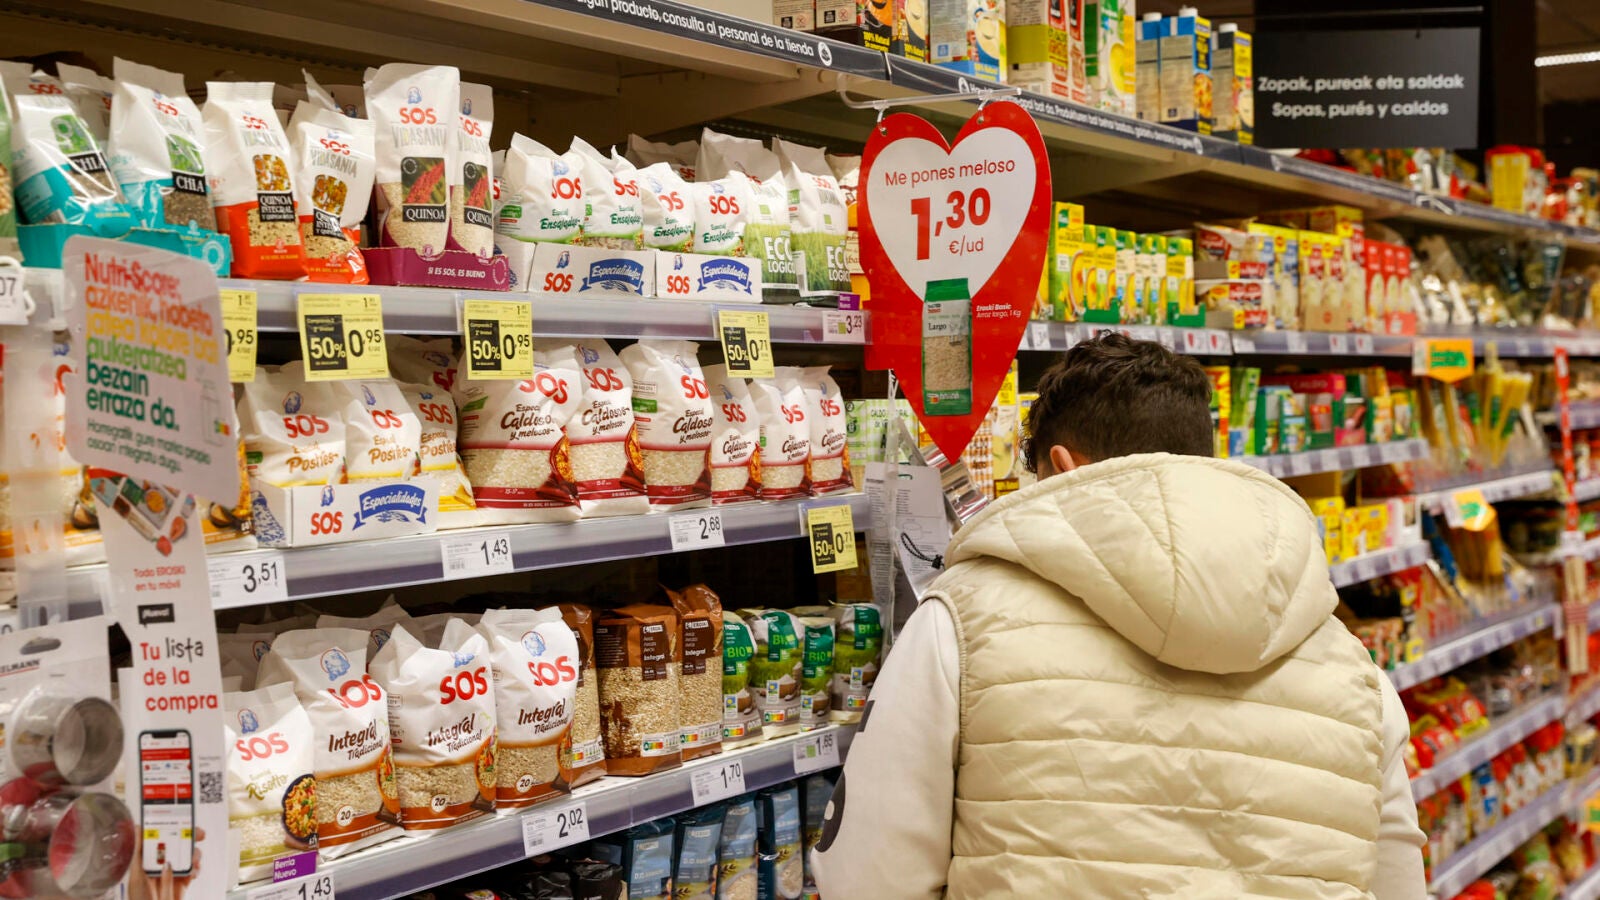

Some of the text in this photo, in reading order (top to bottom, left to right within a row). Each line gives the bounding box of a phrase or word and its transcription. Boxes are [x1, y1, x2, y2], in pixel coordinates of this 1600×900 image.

[611, 0, 814, 56] producto, consulta al personal de la tienda
[1258, 74, 1464, 94] Zopak, pureak eta saldak
[400, 107, 437, 125] SOS
[1272, 100, 1449, 119] Sopas, purés y caldos
[320, 138, 350, 156] SOS
[310, 149, 357, 179] VIDASANIA
[885, 158, 1015, 188] Me pones meloso
[175, 174, 205, 193] CHIA
[259, 195, 293, 207] QUINOA
[261, 205, 294, 215] INTEGRAL
[658, 192, 684, 212] OS
[710, 195, 740, 215] SOS
[406, 211, 445, 222] QUINOA
[467, 212, 492, 225] QUINO
[910, 187, 991, 260] 1,30
[949, 235, 984, 257] €/ud
[428, 267, 486, 279] SI ES SOS, ES BUENO
[544, 272, 574, 292] SOS
[591, 264, 642, 281] Especialidades
[702, 264, 748, 281] Especialidades
[667, 275, 690, 295] SOS
[846, 315, 862, 334] 3,23
[310, 337, 347, 359] 50%
[348, 329, 382, 358] 0,95
[472, 340, 501, 360] 50%
[503, 334, 530, 360] 0,95
[728, 344, 748, 361] 50%
[749, 339, 769, 361] 0,71
[86, 355, 149, 397] bezain
[582, 367, 624, 392] SOS
[680, 374, 710, 399] SO
[86, 388, 180, 432] erraza da.
[366, 410, 403, 430] OS
[419, 402, 454, 425] SOS
[500, 411, 553, 429] Caldoso
[581, 406, 630, 426] Caldosos
[722, 402, 747, 423] SOS
[283, 414, 329, 438] SOS
[672, 416, 713, 434] Caldoso
[362, 490, 422, 512] Especialidades
[311, 511, 344, 535] SOS
[699, 516, 721, 539] 2,68
[480, 538, 508, 566] 1,43
[815, 539, 836, 556] 50%
[835, 531, 853, 554] 0,71
[134, 568, 155, 578] Todo
[242, 561, 279, 593] 3,51
[136, 579, 181, 592] en tu móvil
[140, 637, 204, 663] Tu lista
[644, 653, 665, 661] Integral
[685, 648, 706, 656] Integral
[727, 646, 746, 658] BIO
[808, 651, 826, 662] BIO
[143, 667, 190, 686] de la
[528, 655, 576, 687] SOS
[440, 666, 488, 705] SOS
[145, 694, 218, 714] compra
[518, 698, 566, 726] Integral
[328, 718, 377, 753] Integral
[428, 713, 476, 747] Integral
[236, 731, 289, 761] SOS
[519, 778, 531, 788] 20
[720, 763, 741, 789] 1,70
[434, 797, 446, 806] 20
[340, 810, 351, 820] 20
[557, 808, 584, 838] 2,02
[275, 857, 295, 870] Berria
[274, 868, 297, 880] Nuevo
[298, 877, 332, 900] 1,43
